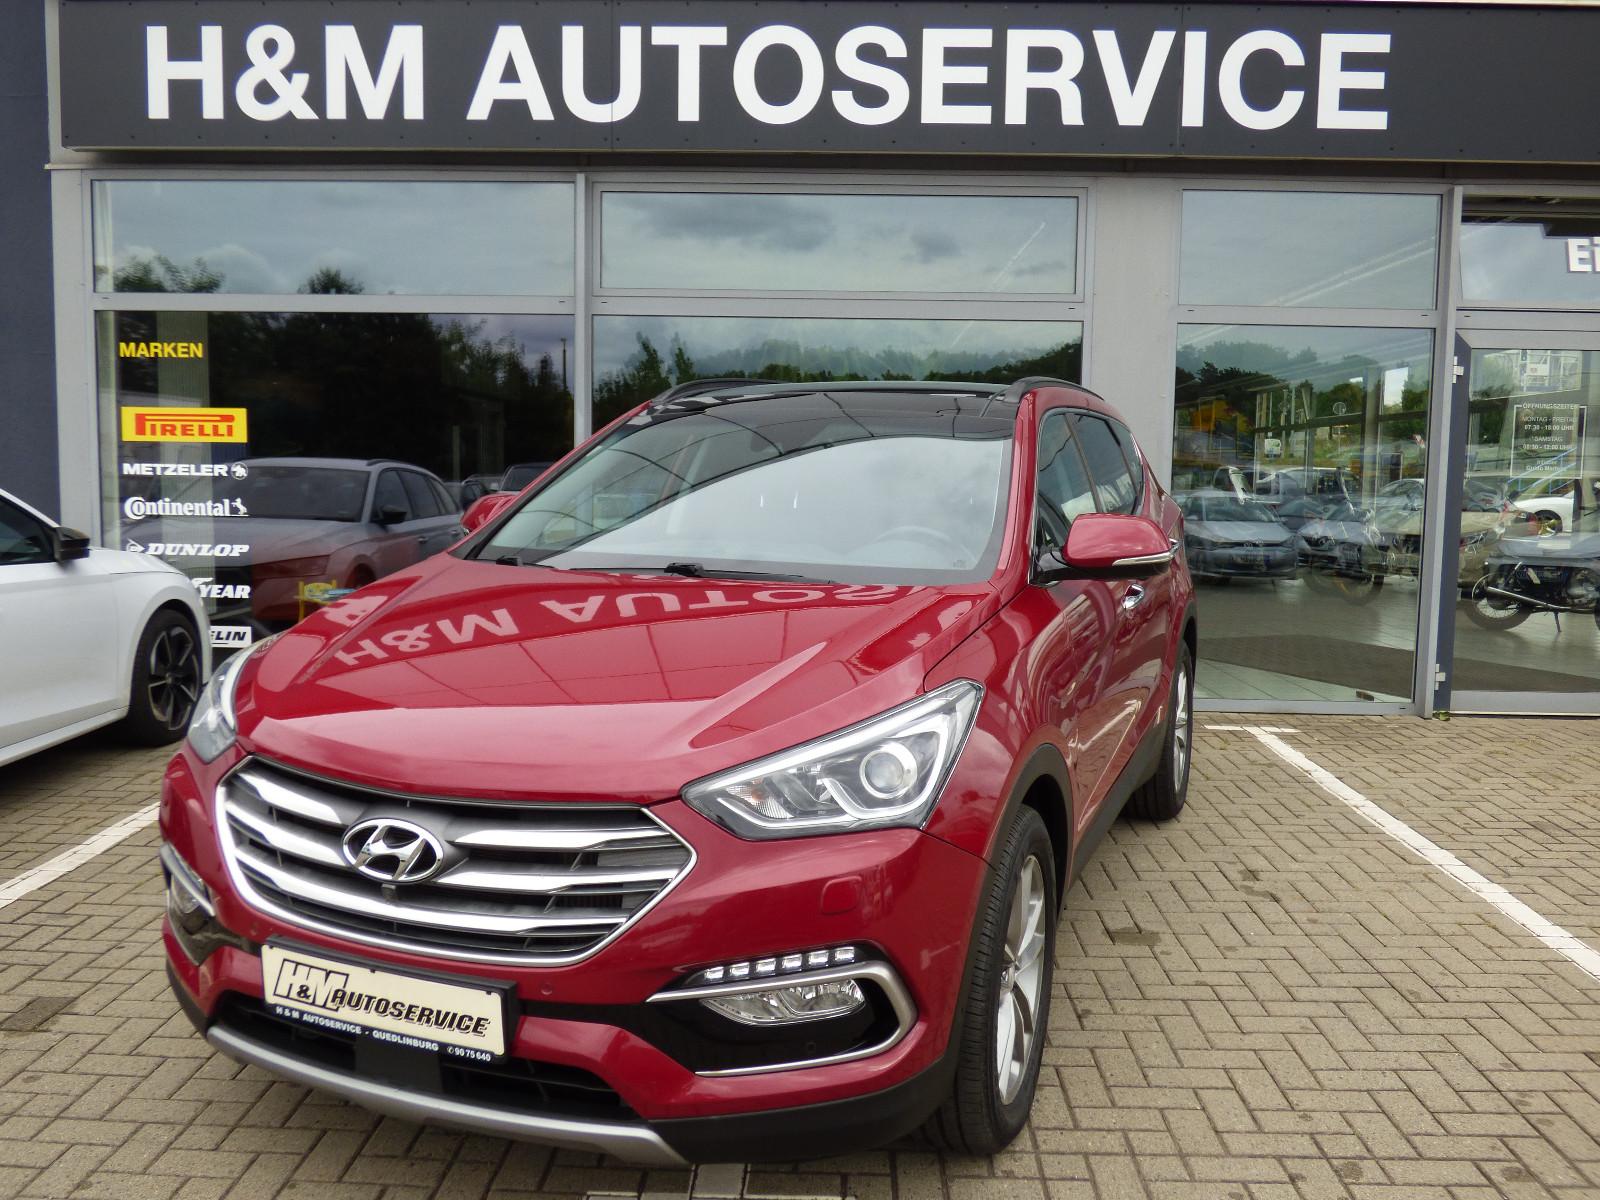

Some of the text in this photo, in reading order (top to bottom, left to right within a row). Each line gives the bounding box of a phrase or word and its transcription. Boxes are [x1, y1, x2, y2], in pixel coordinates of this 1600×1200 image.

[146, 25, 1391, 131] H&M AUTOSERVICE
[119, 342, 203, 358] MARKEN
[135, 413, 234, 437] PIRELLI
[122, 463, 229, 477] METZELER
[124, 496, 231, 520] Continental
[145, 543, 250, 557] DUNLOP
[200, 584, 251, 599] YEAR
[273, 957, 491, 1038] H&M AUTOSERVICE
[302, 1013, 362, 1035] AUTOSERVICE
[372, 1030, 439, 1052] QUEDLINBURG
[465, 1049, 475, 1059] 75
[476, 1051, 491, 1062] 640
